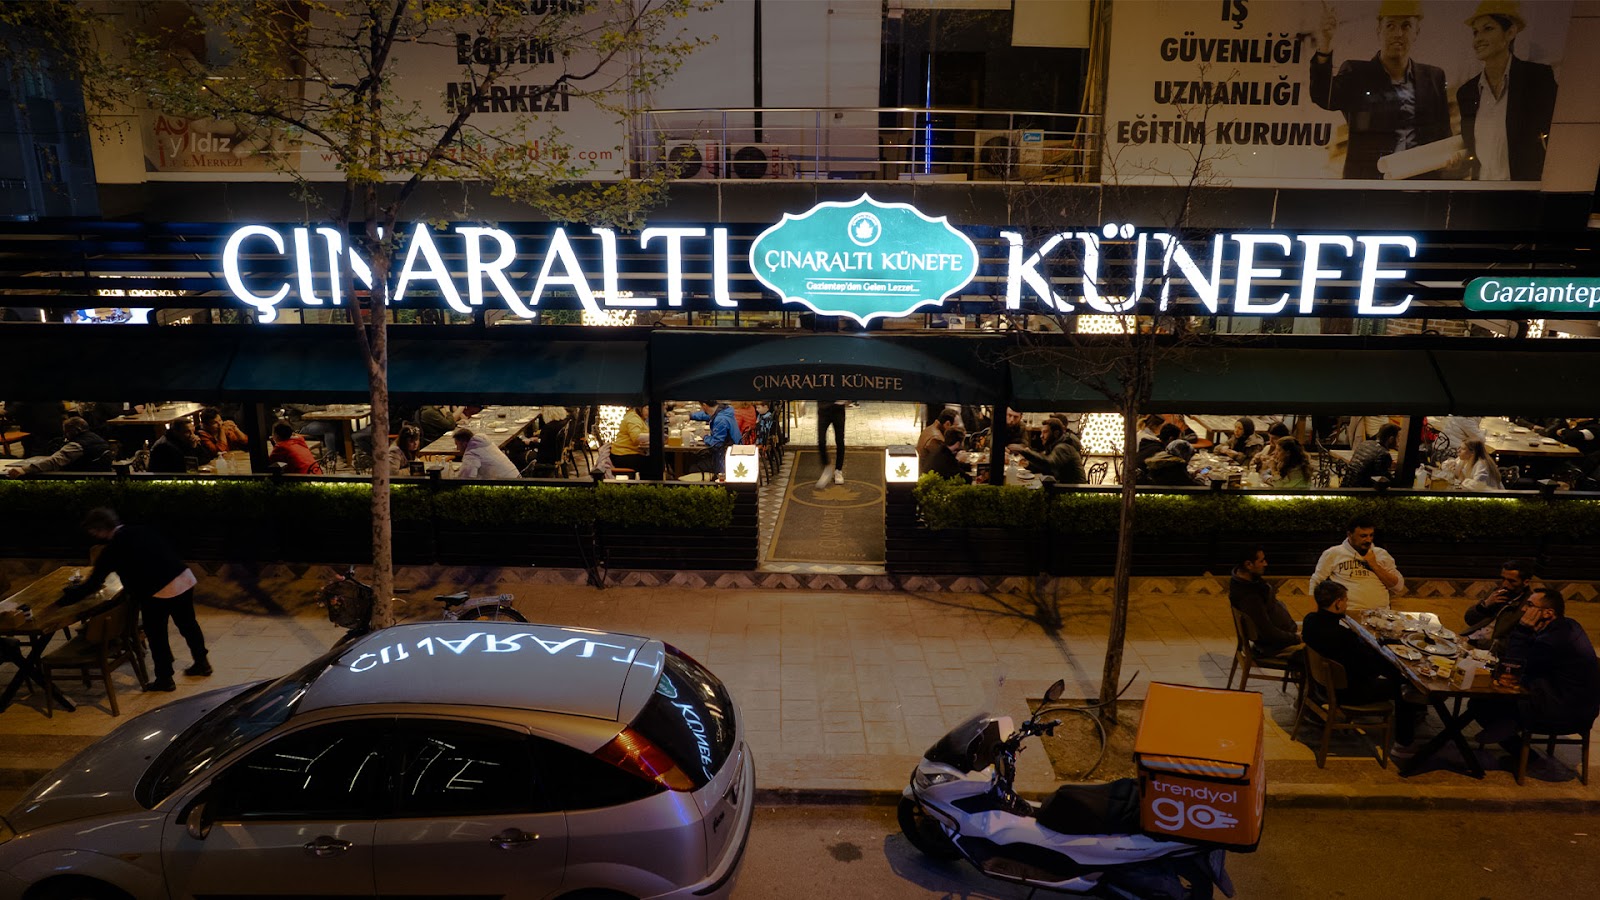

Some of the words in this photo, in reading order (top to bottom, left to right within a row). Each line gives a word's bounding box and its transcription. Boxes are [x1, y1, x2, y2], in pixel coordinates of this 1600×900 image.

[1160, 31, 1303, 64] GÜVENLİĞİ
[1154, 75, 1300, 106] UZMANLIĞI
[1117, 114, 1206, 146] EĞİTİM
[1216, 121, 1332, 146] KURUMU
[765, 249, 874, 273] ÇINARALTI
[881, 251, 963, 271] KÜNEFE
[999, 222, 1417, 315] KÜNEFE
[863, 282, 887, 291] Gelen
[752, 373, 835, 392] ÇINARALTI
[842, 373, 903, 391] KÜNEFE
[1151, 780, 1238, 804] trendyol
[1151, 797, 1226, 831] go
